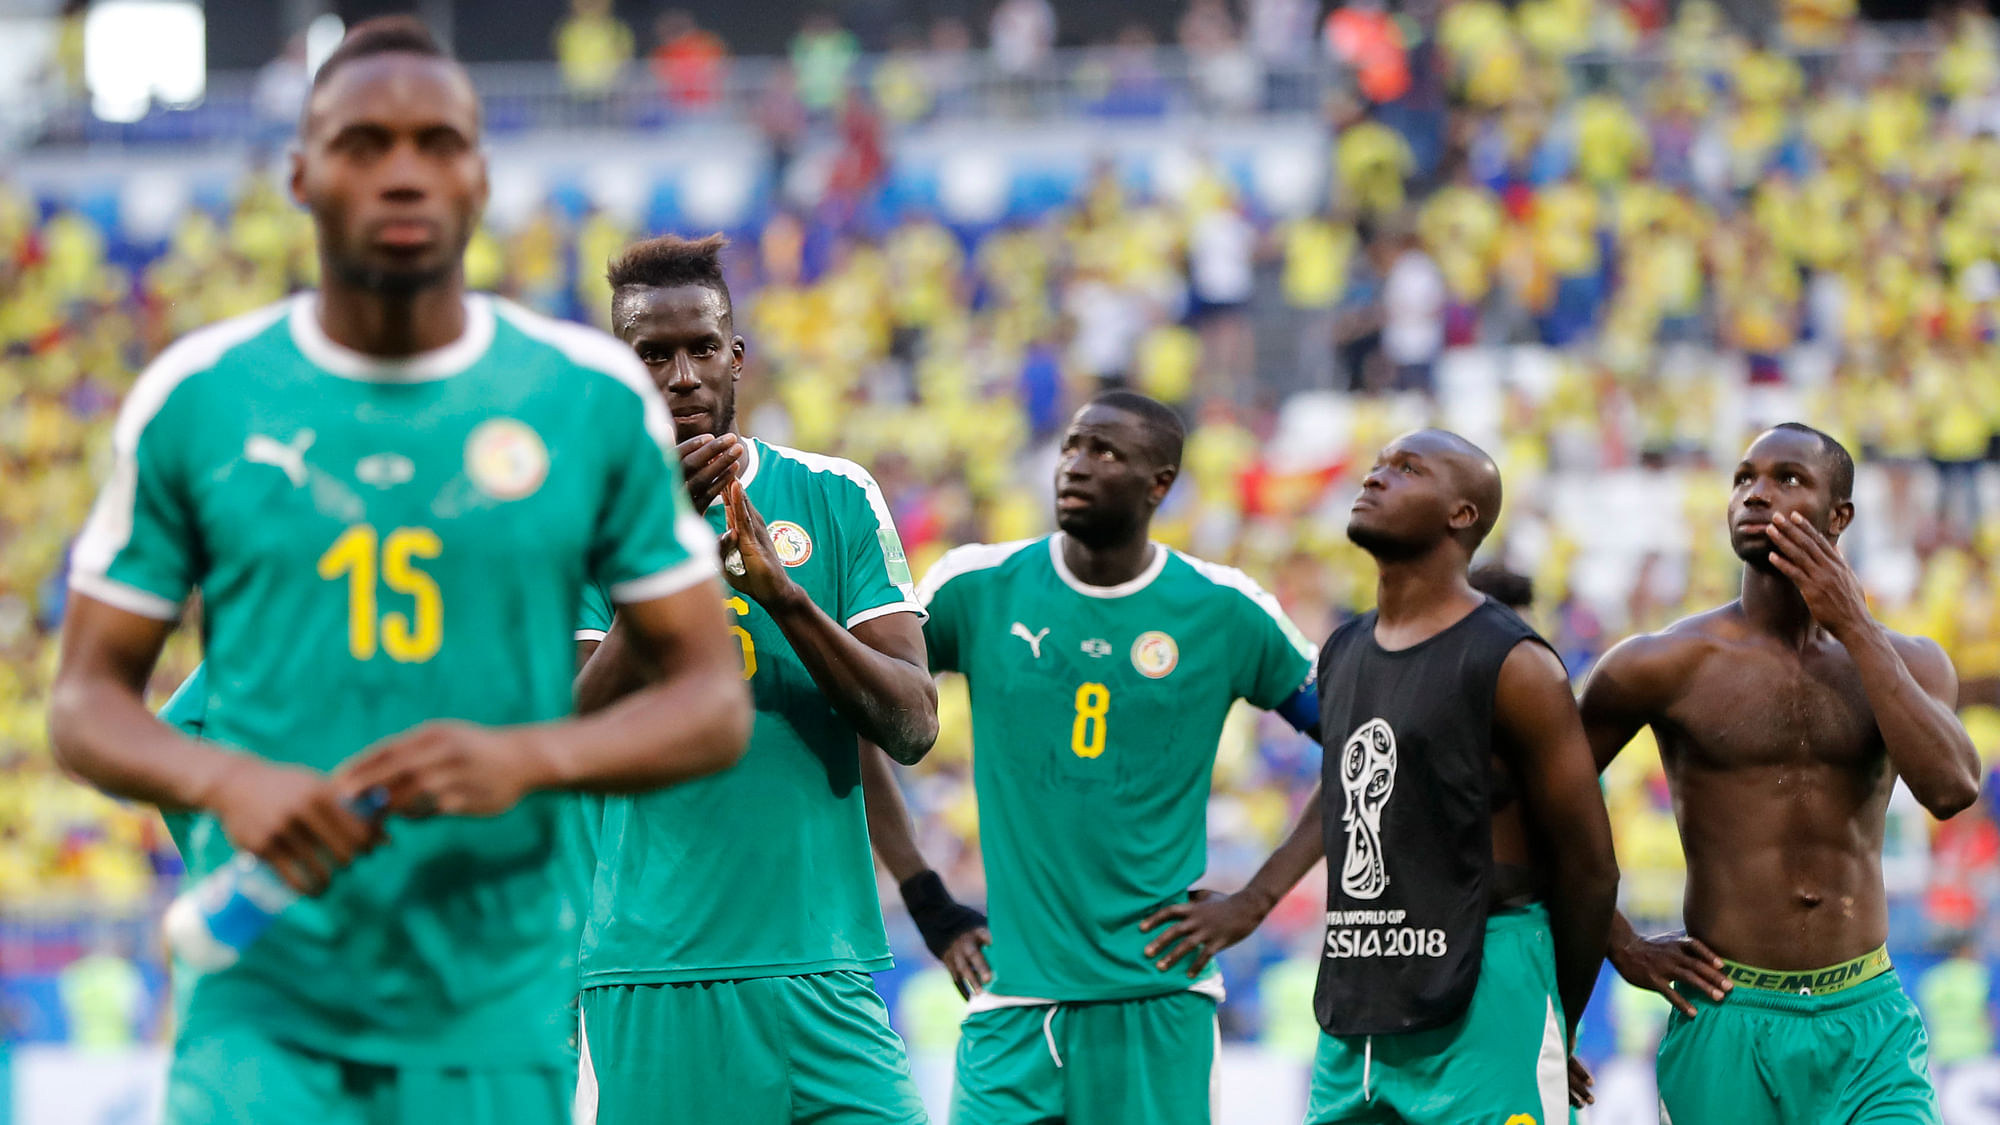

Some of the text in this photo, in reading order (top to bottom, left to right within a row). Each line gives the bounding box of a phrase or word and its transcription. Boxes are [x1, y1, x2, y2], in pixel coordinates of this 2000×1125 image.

[317, 524, 443, 663] 15
[1071, 682, 1110, 758] 8
[1343, 910, 1386, 925] WORLD
[1387, 909, 1406, 924] CUP
[1384, 927, 1448, 957] 2018
